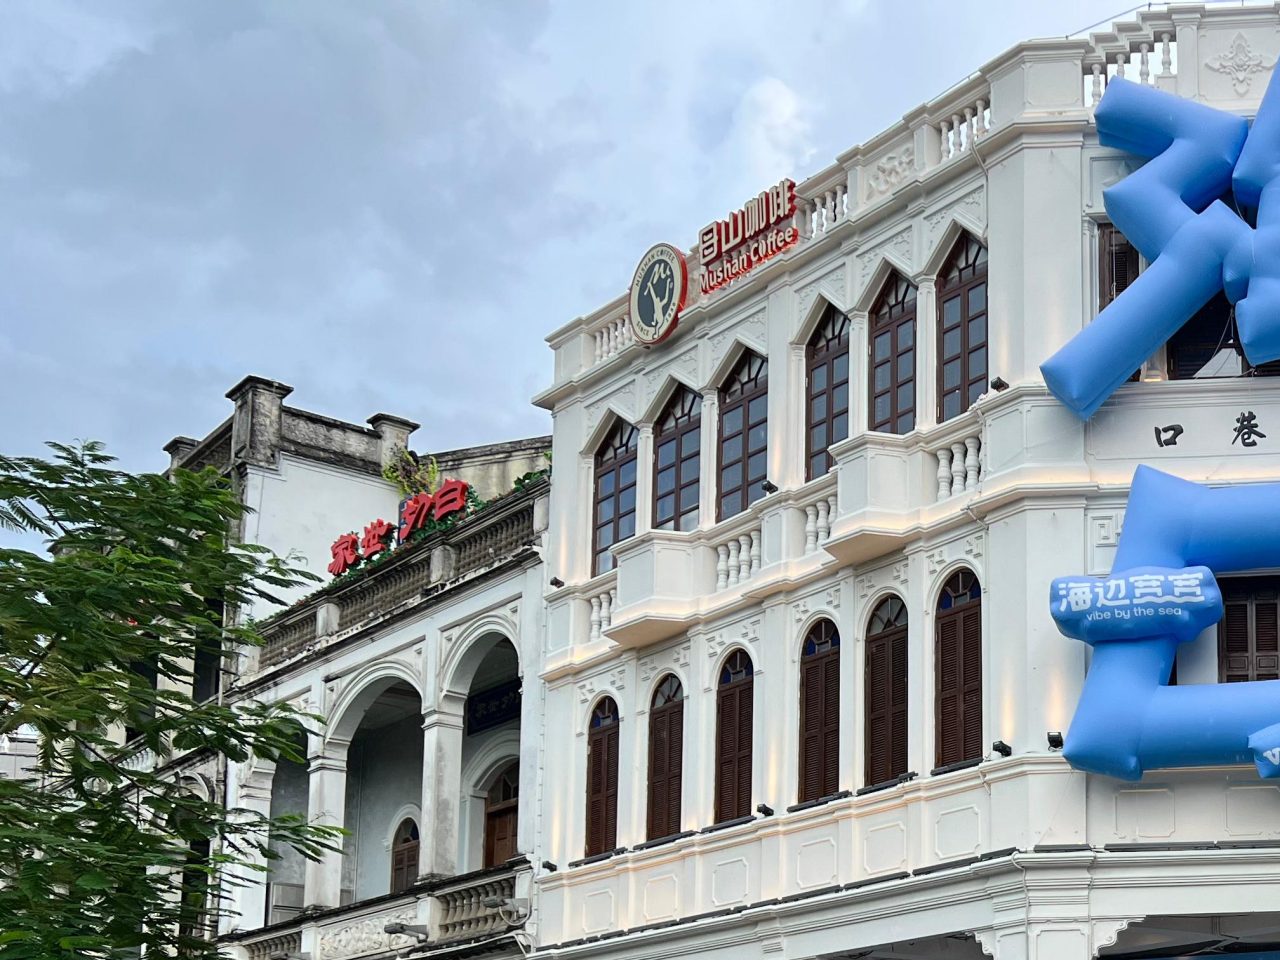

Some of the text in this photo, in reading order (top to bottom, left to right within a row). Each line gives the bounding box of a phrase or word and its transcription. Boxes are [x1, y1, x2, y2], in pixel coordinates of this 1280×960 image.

[700, 254, 749, 293] Mushan
[1086, 606, 1182, 621] vibe by the sea
